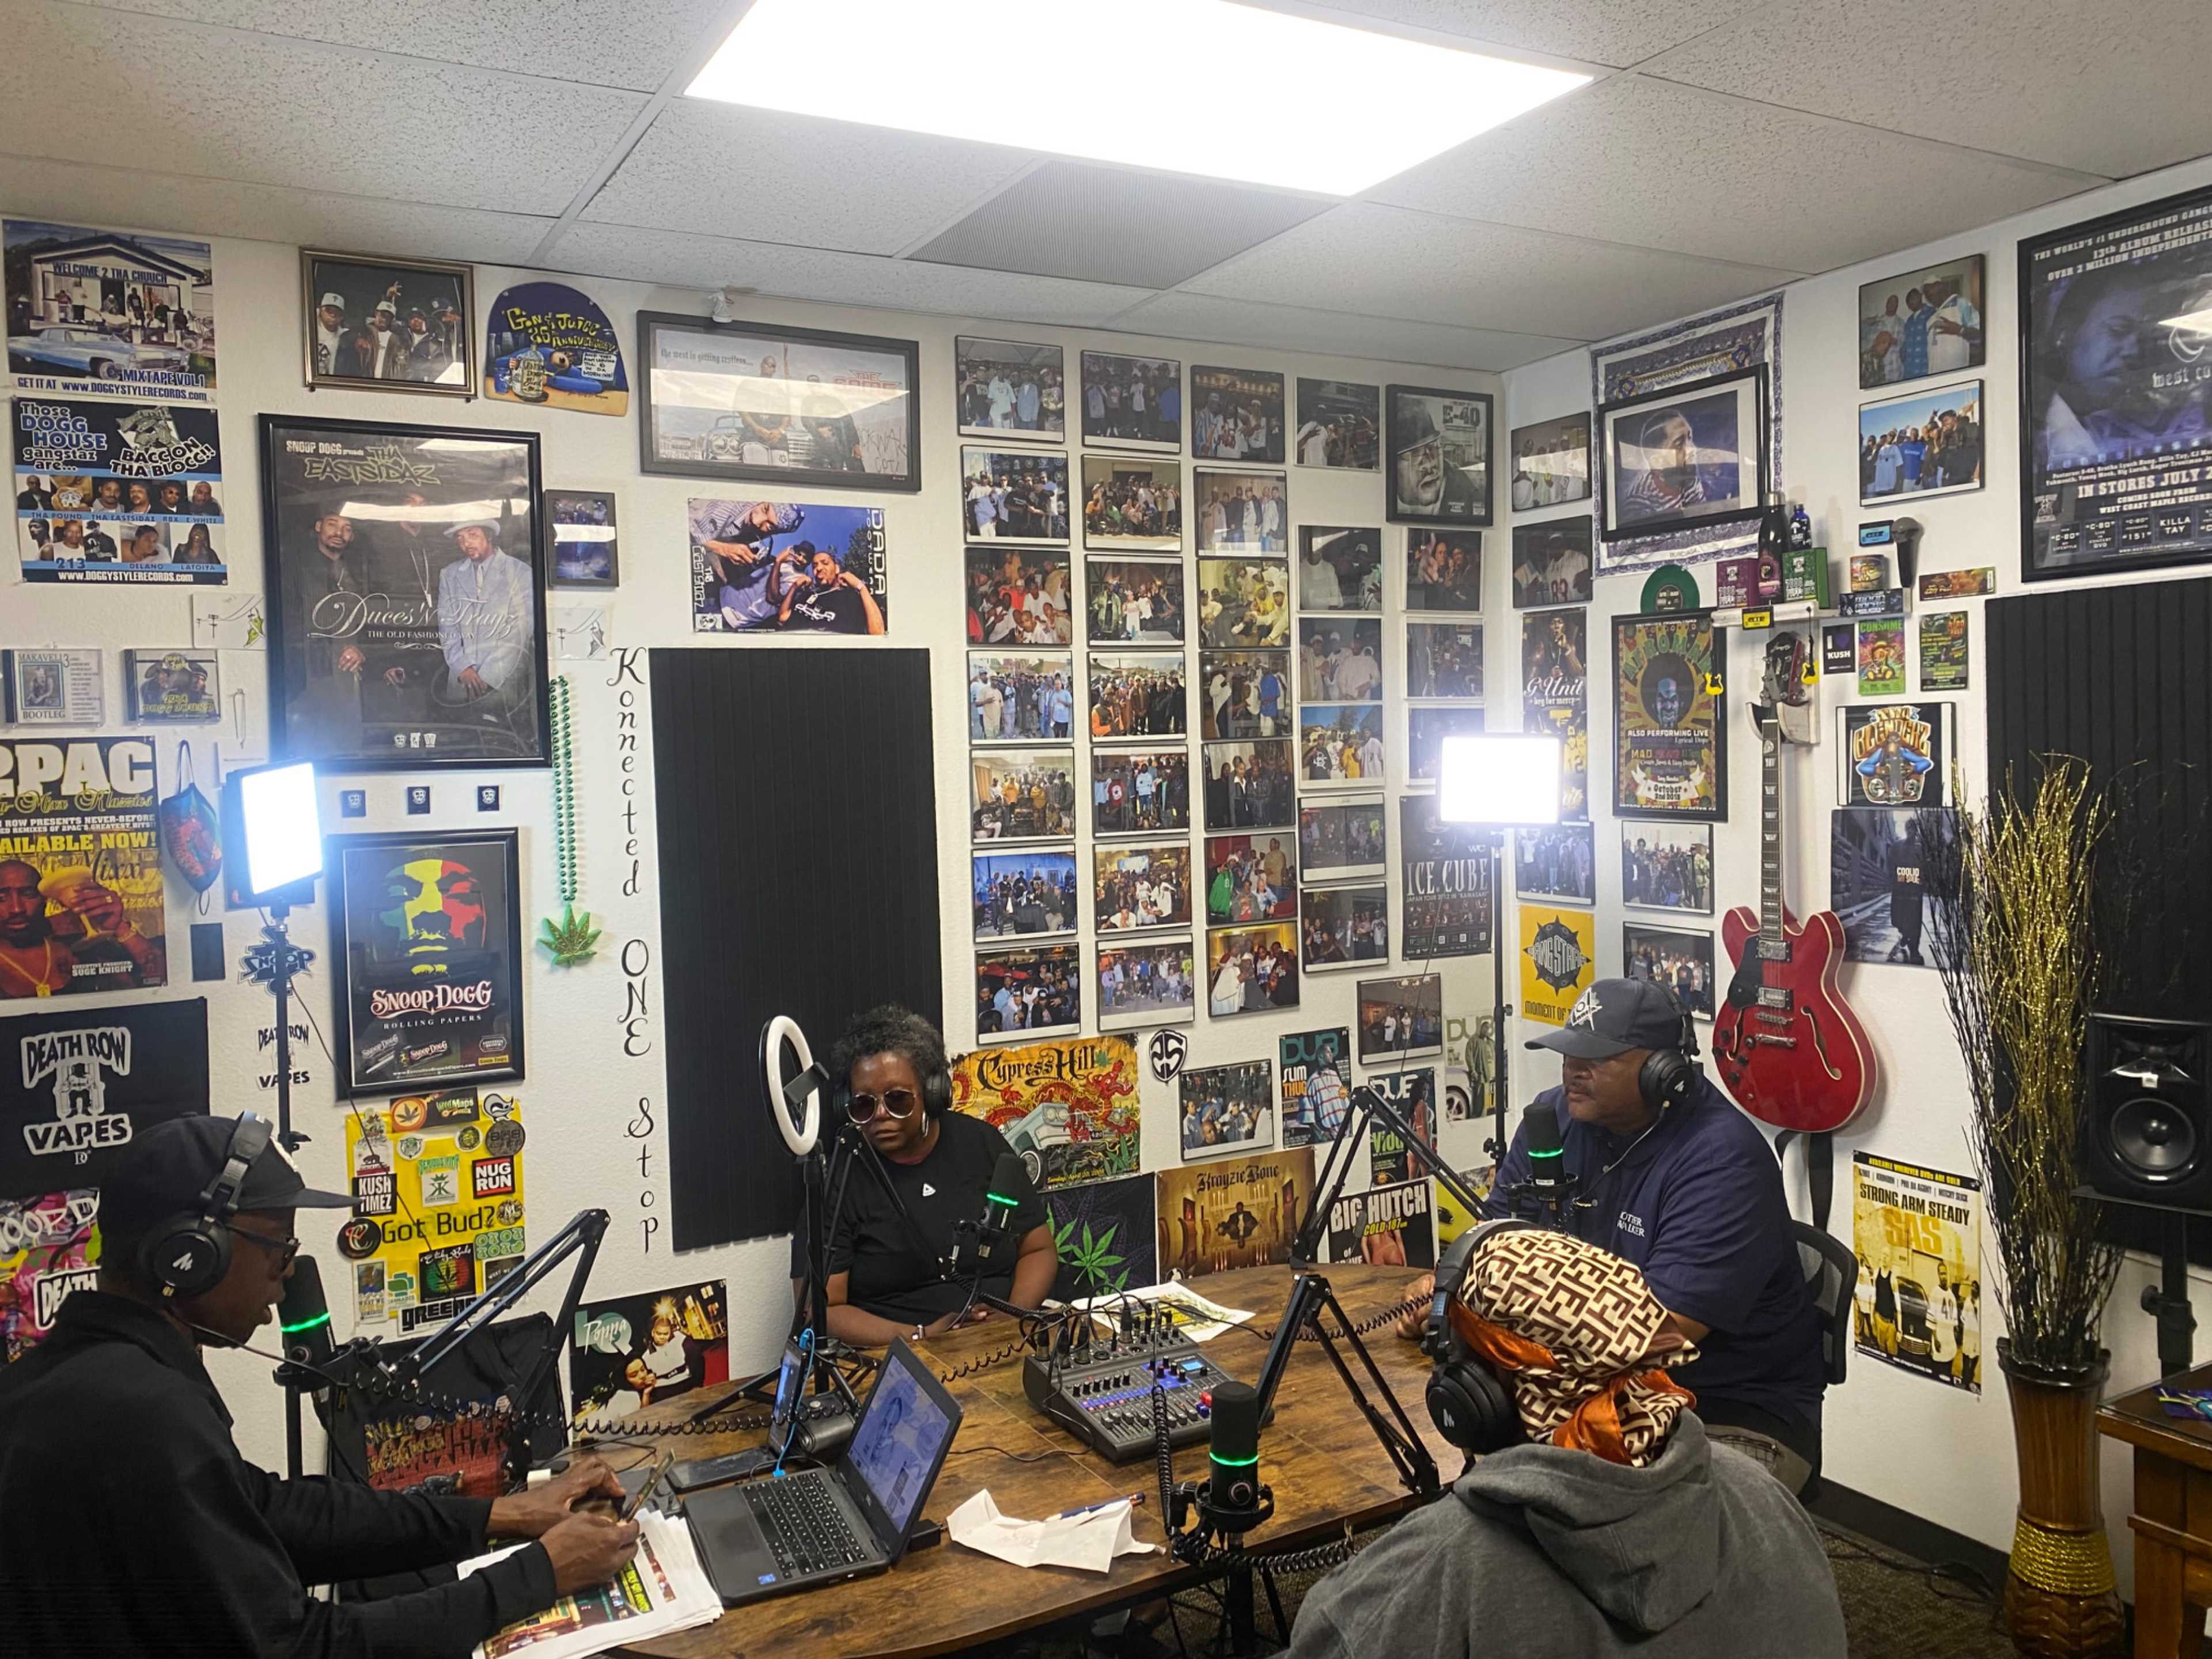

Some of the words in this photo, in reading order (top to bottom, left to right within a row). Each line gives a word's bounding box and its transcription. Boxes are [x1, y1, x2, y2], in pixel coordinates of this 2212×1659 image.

[2108, 215, 2178, 241] UNDERGROUND
[2119, 232, 2161, 252] ALBUM
[2085, 253, 2129, 271] MILLION
[53, 262, 98, 276] WELCOME
[102, 267, 108, 276] 2
[111, 269, 129, 281] THA
[673, 350, 689, 359] west
[123, 370, 174, 385] MIXTAPE
[18, 377, 34, 389] GET
[36, 378, 44, 389] IT
[45, 378, 56, 389] AT
[61, 381, 207, 402] www.DOGGYSTYLERECORDS.com
[20, 403, 70, 417] Those
[1442, 404, 1480, 427] E-40
[21, 414, 88, 432] DOGG
[32, 431, 107, 450] HOUSE
[120, 448, 172, 462] BACC
[171, 437, 202, 460] ON
[286, 440, 316, 454] SNOOP
[319, 442, 342, 455] DOGG
[22, 446, 98, 462] gangstaz
[109, 460, 149, 478] THA
[304, 457, 441, 487] EASTSIDAZ
[2078, 485, 2094, 498] IN
[2099, 475, 2156, 495] STORES
[2161, 468, 2200, 486] JULY
[2099, 506, 2120, 514] WEST
[2122, 502, 2148, 511] COAST
[2160, 516, 2191, 527] KILLA
[2165, 526, 2186, 534] TAY
[871, 509, 886, 594] DADA
[56, 558, 86, 570] 213
[129, 562, 164, 570] DELANO
[368, 630, 384, 638] THE
[18, 653, 63, 662] MAKAVELI
[1827, 650, 1851, 660] KUSH
[22, 710, 65, 719] BOOTLEG
[1647, 729, 1692, 737] PERFORMING
[606, 646, 647, 897] Konnected
[1654, 784, 1682, 793] October
[6, 819, 26, 827] ROW
[31, 817, 82, 826] PRESENTS
[85, 814, 155, 824] NEVER-BEFORE
[101, 832, 157, 849] NOW!
[1442, 858, 1488, 893] CUBE
[1897, 867, 1920, 877] COOLIO
[72, 967, 96, 976] SUGE
[98, 965, 133, 975] KNIGHT
[371, 986, 434, 1015] SNOOP
[434, 980, 493, 1007] DOGG
[618, 938, 653, 1058] ONE
[1525, 1000, 1556, 1019] MOMENT
[1557, 1006, 1566, 1020] OF
[384, 1018, 434, 1029] ROLLING
[441, 1015, 482, 1024] PAPERS
[289, 1024, 309, 1046] ROW
[26, 1037, 84, 1081] DEATH
[86, 1031, 127, 1073] ROW
[978, 1051, 1054, 1090] Cypress
[1043, 1046, 1096, 1082] Hill
[1282, 1065, 1306, 1083] SLIM
[1282, 1081, 1307, 1097] THUG
[28, 1117, 128, 1151] VAPES
[476, 1162, 512, 1178] NUG
[624, 1096, 658, 1253] Stop
[1196, 1171, 1245, 1194] Krayzie
[1245, 1164, 1279, 1184] Bone
[359, 1176, 391, 1195] KUSH
[476, 1175, 512, 1190] RUN
[1367, 1183, 1427, 1226] HUTCH
[1859, 1183, 1898, 1207] STRONG
[1901, 1194, 1925, 1215] ARM
[1929, 1201, 1970, 1226] STEADY
[1330, 1198, 1363, 1233] BIG
[381, 1219, 427, 1244] Got
[437, 1206, 495, 1236] Bud?
[1363, 1221, 1385, 1236] COLD
[1883, 1207, 1943, 1255] SAS
[583, 1319, 627, 1355] Poppa
